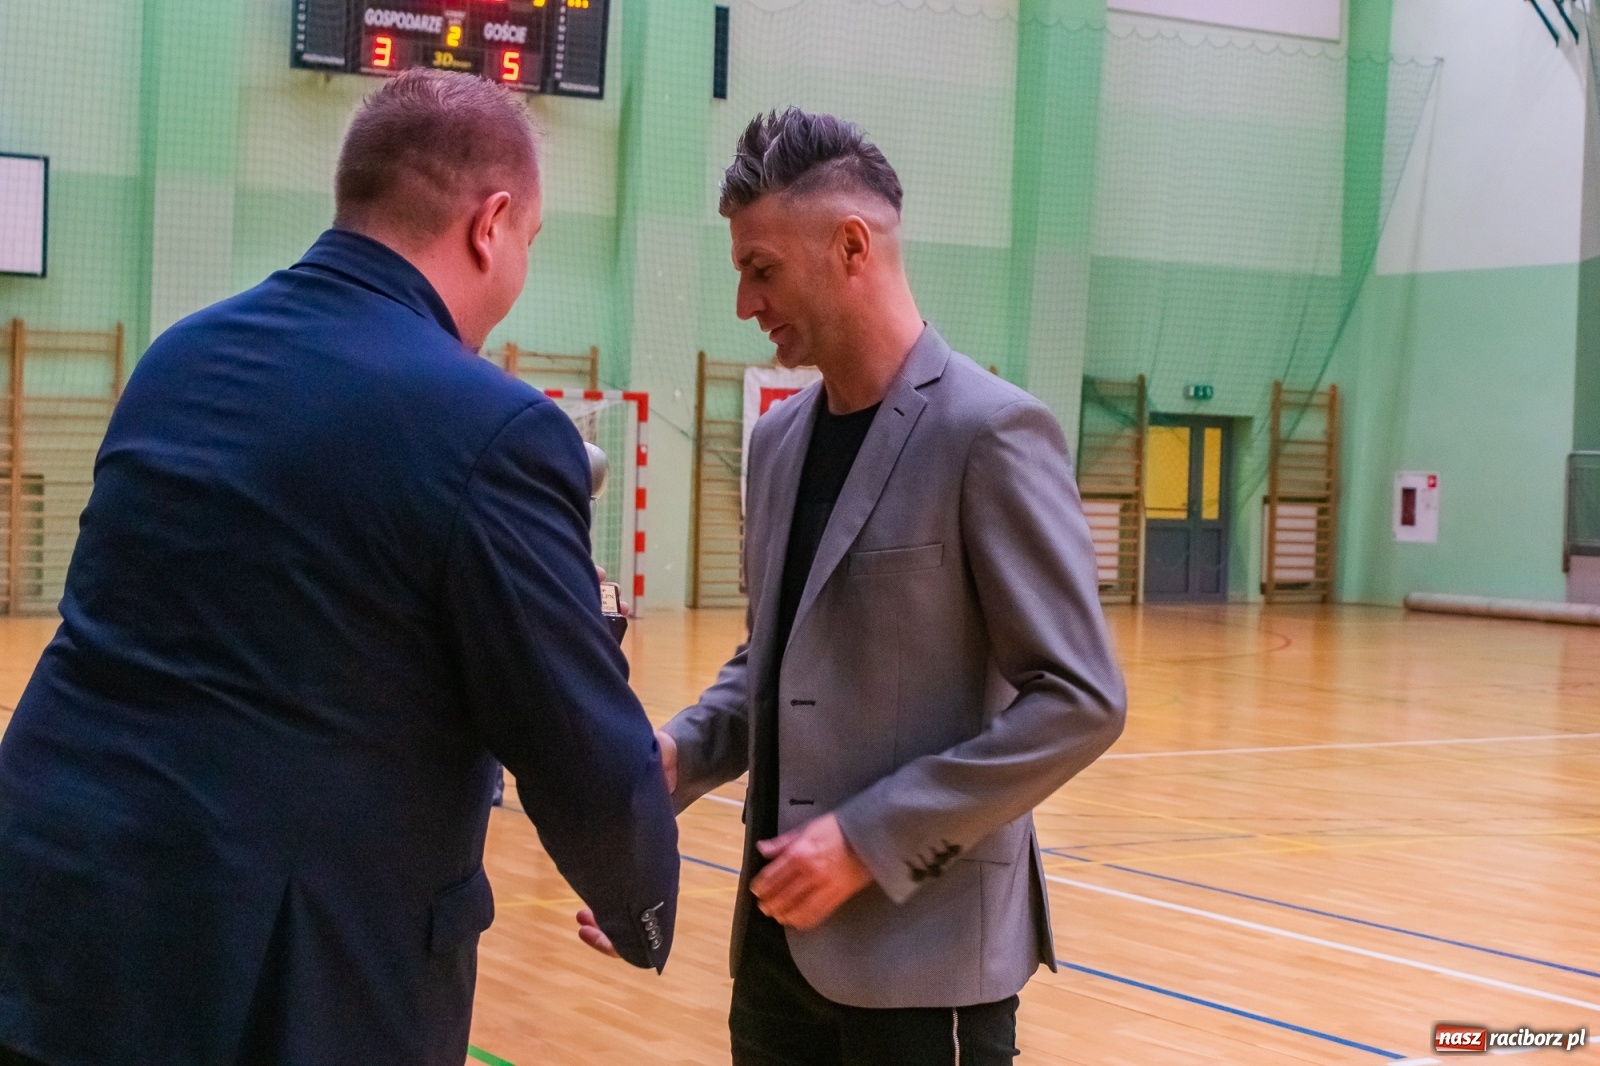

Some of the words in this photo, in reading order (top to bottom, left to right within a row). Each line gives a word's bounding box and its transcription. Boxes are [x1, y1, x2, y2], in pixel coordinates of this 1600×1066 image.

[364, 9, 443, 33] GOSPODARZE
[483, 21, 527, 44] GOŚCIE
[446, 25, 461, 47] 2
[373, 36, 392, 67] 3
[502, 51, 520, 81] 5
